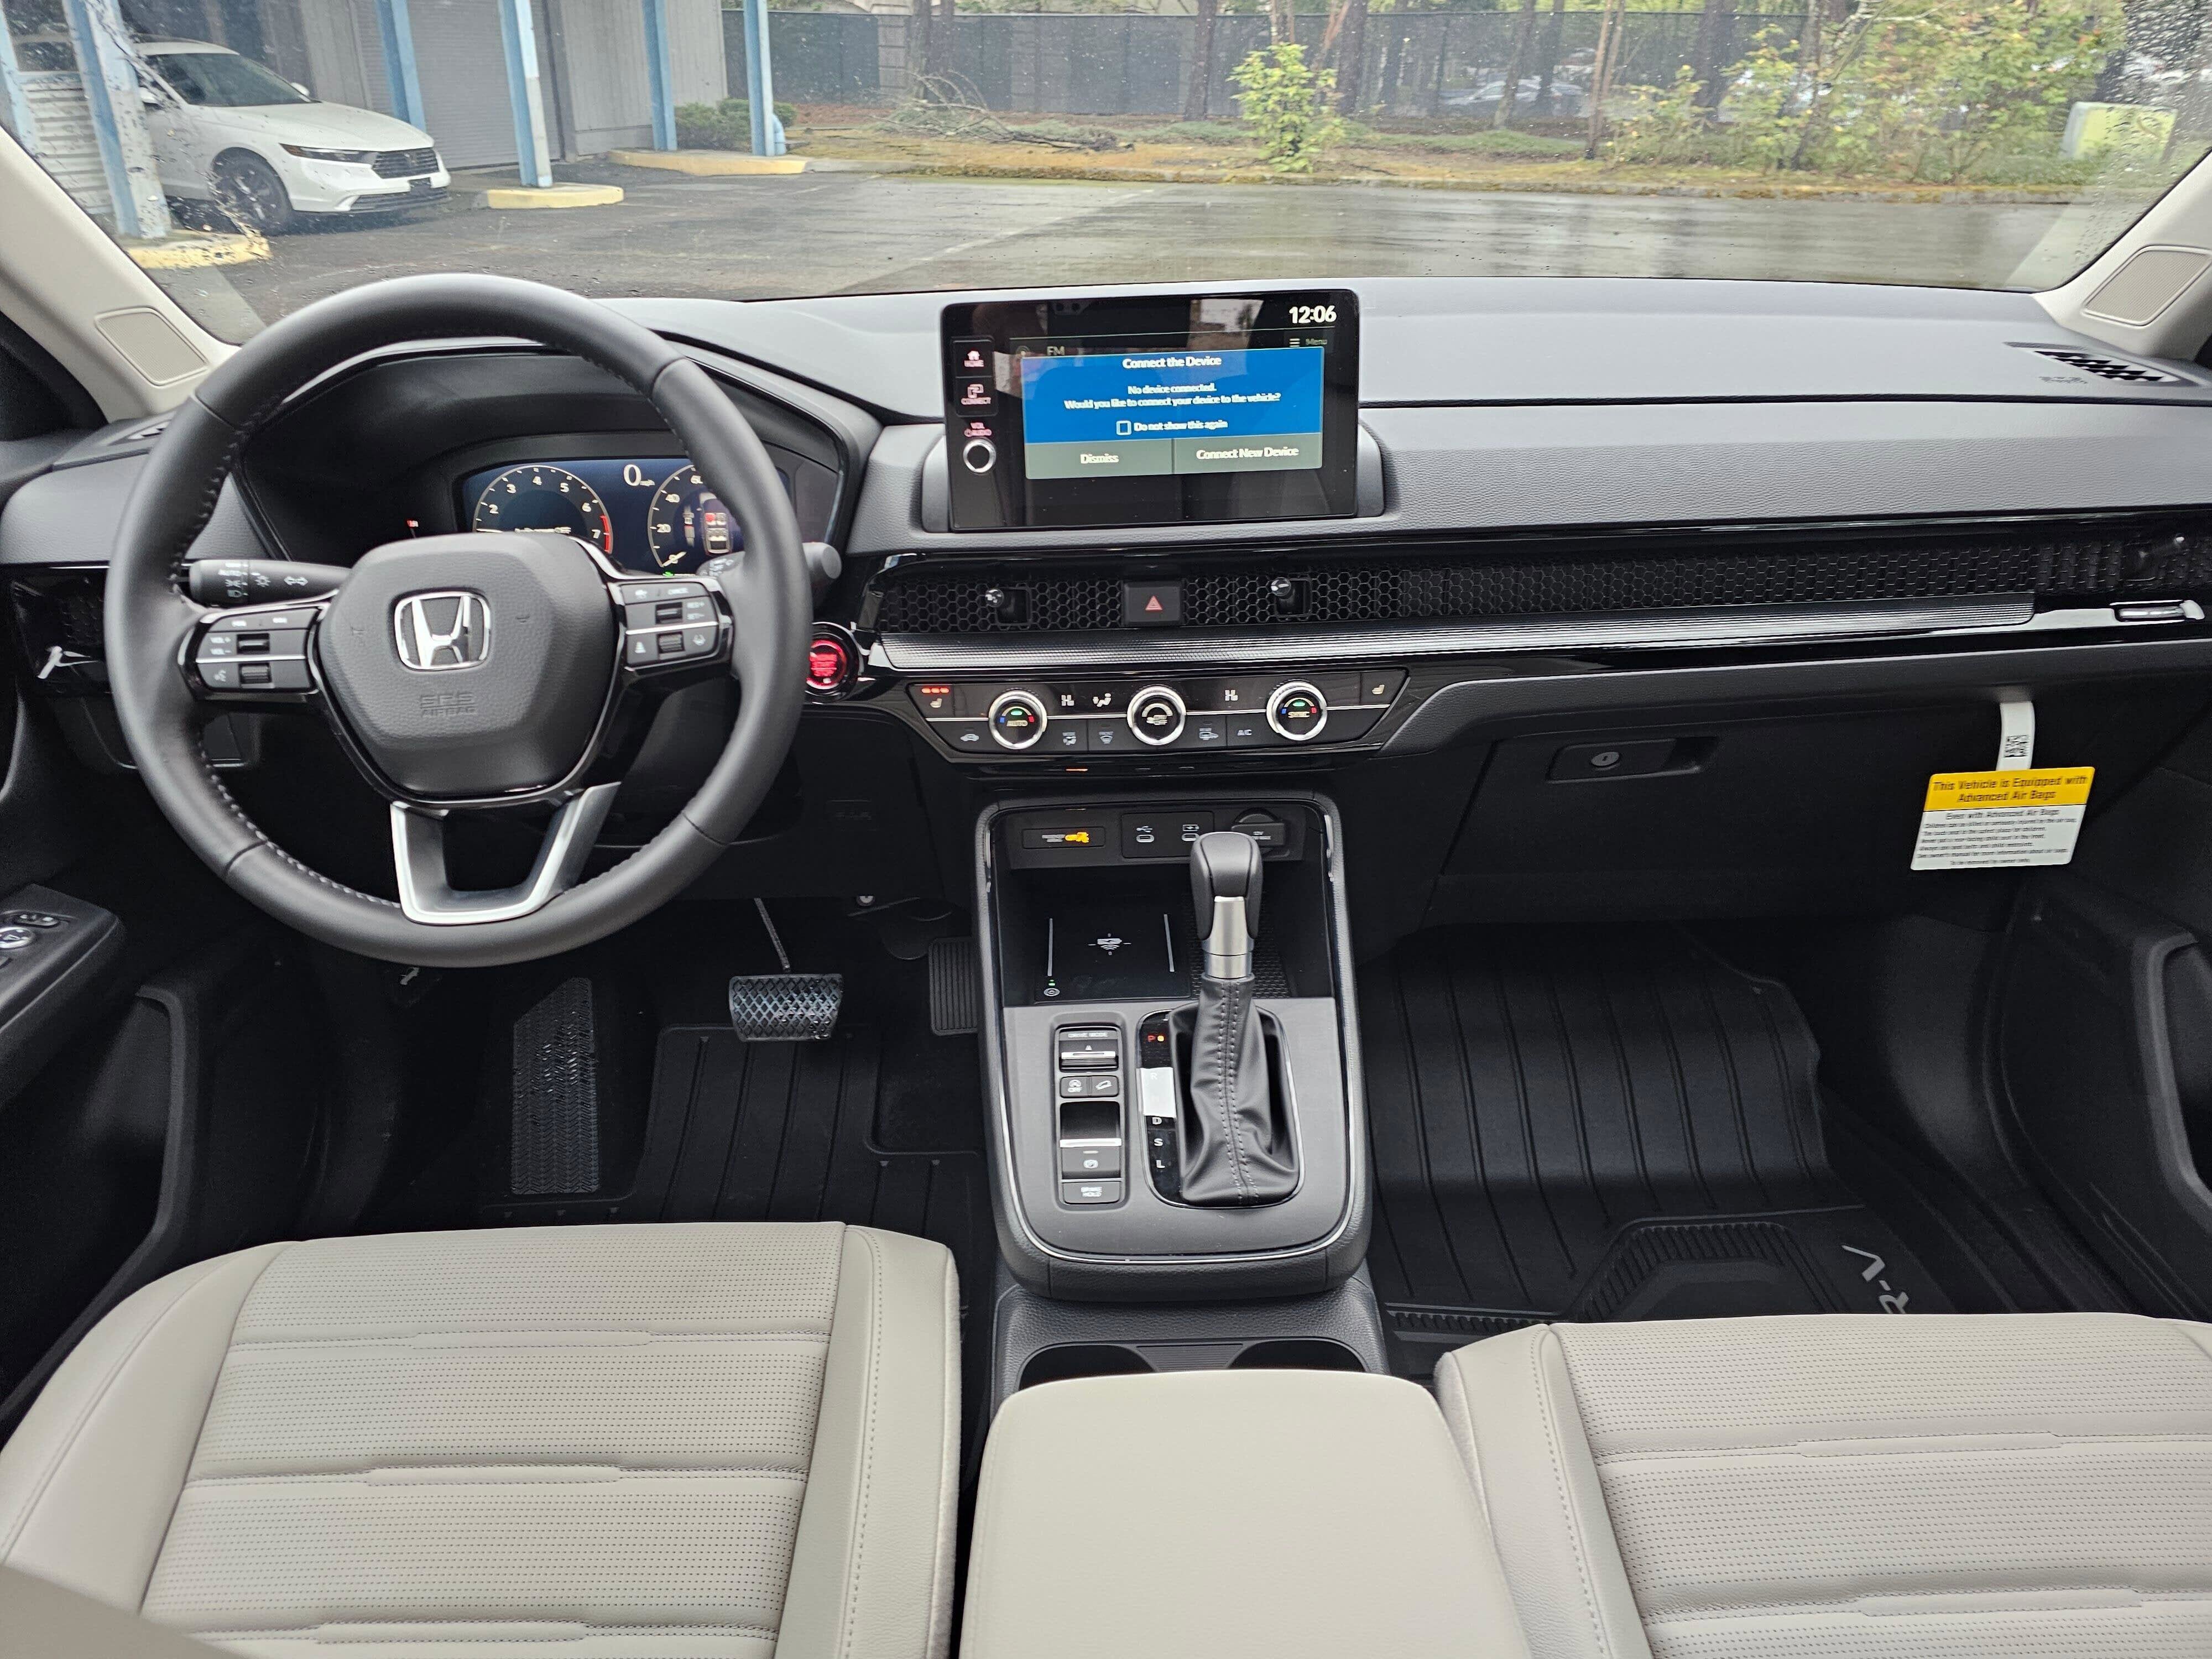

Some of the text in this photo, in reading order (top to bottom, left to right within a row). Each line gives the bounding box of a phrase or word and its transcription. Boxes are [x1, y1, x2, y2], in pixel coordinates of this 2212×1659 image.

[1289, 305, 1337, 324] 12:06
[1046, 346, 1065, 356] FM
[1122, 356, 1222, 368] Connect the Device
[1128, 386, 1142, 394] No
[1142, 384, 1169, 394] device
[1064, 392, 1281, 409] Would you like to connect your device to the vehicle?
[1134, 419, 1228, 431] Do not show this again
[1080, 453, 1119, 464] Dismiss
[1196, 446, 1300, 461] Connect New Device
[623, 464, 641, 486] 0
[532, 476, 542, 486] 4
[506, 483, 517, 494] 3
[560, 482, 570, 493] 5
[488, 504, 499, 514] 2
[581, 502, 592, 512] 6
[657, 523, 671, 533] 20
[591, 529, 601, 539] 7
[1933, 775, 2088, 791] This Vehicle is Equipped with
[1957, 789, 2056, 802] Advanced Air Bags
[1152, 1116, 1162, 1125] D
[1154, 1138, 1164, 1147] S
[1156, 1160, 1166, 1169] L
